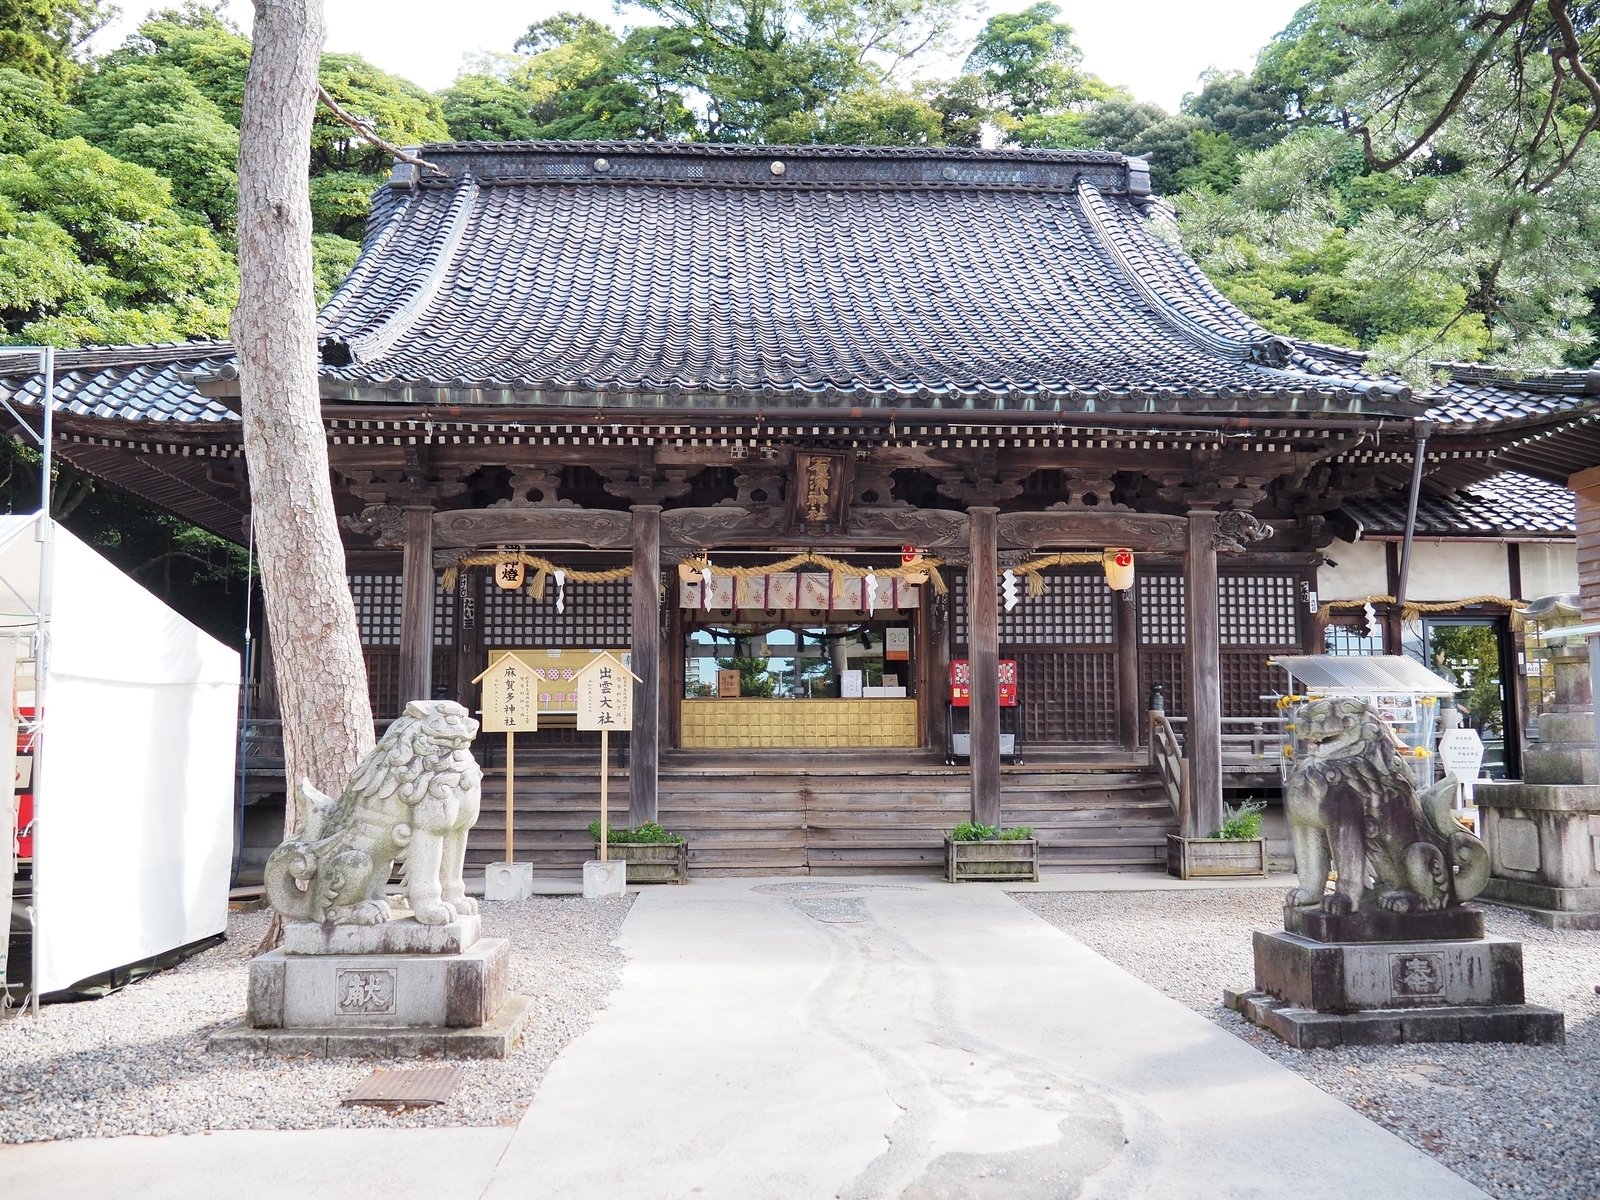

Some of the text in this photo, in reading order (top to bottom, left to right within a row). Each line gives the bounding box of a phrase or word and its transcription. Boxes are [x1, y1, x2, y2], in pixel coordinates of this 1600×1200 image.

[805, 456, 832, 521] 石浦神社
[503, 666, 517, 727] 麻賀多神社
[597, 666, 615, 725] 出雲大社
[342, 974, 386, 1006] 献
[1397, 957, 1436, 993] 奉
